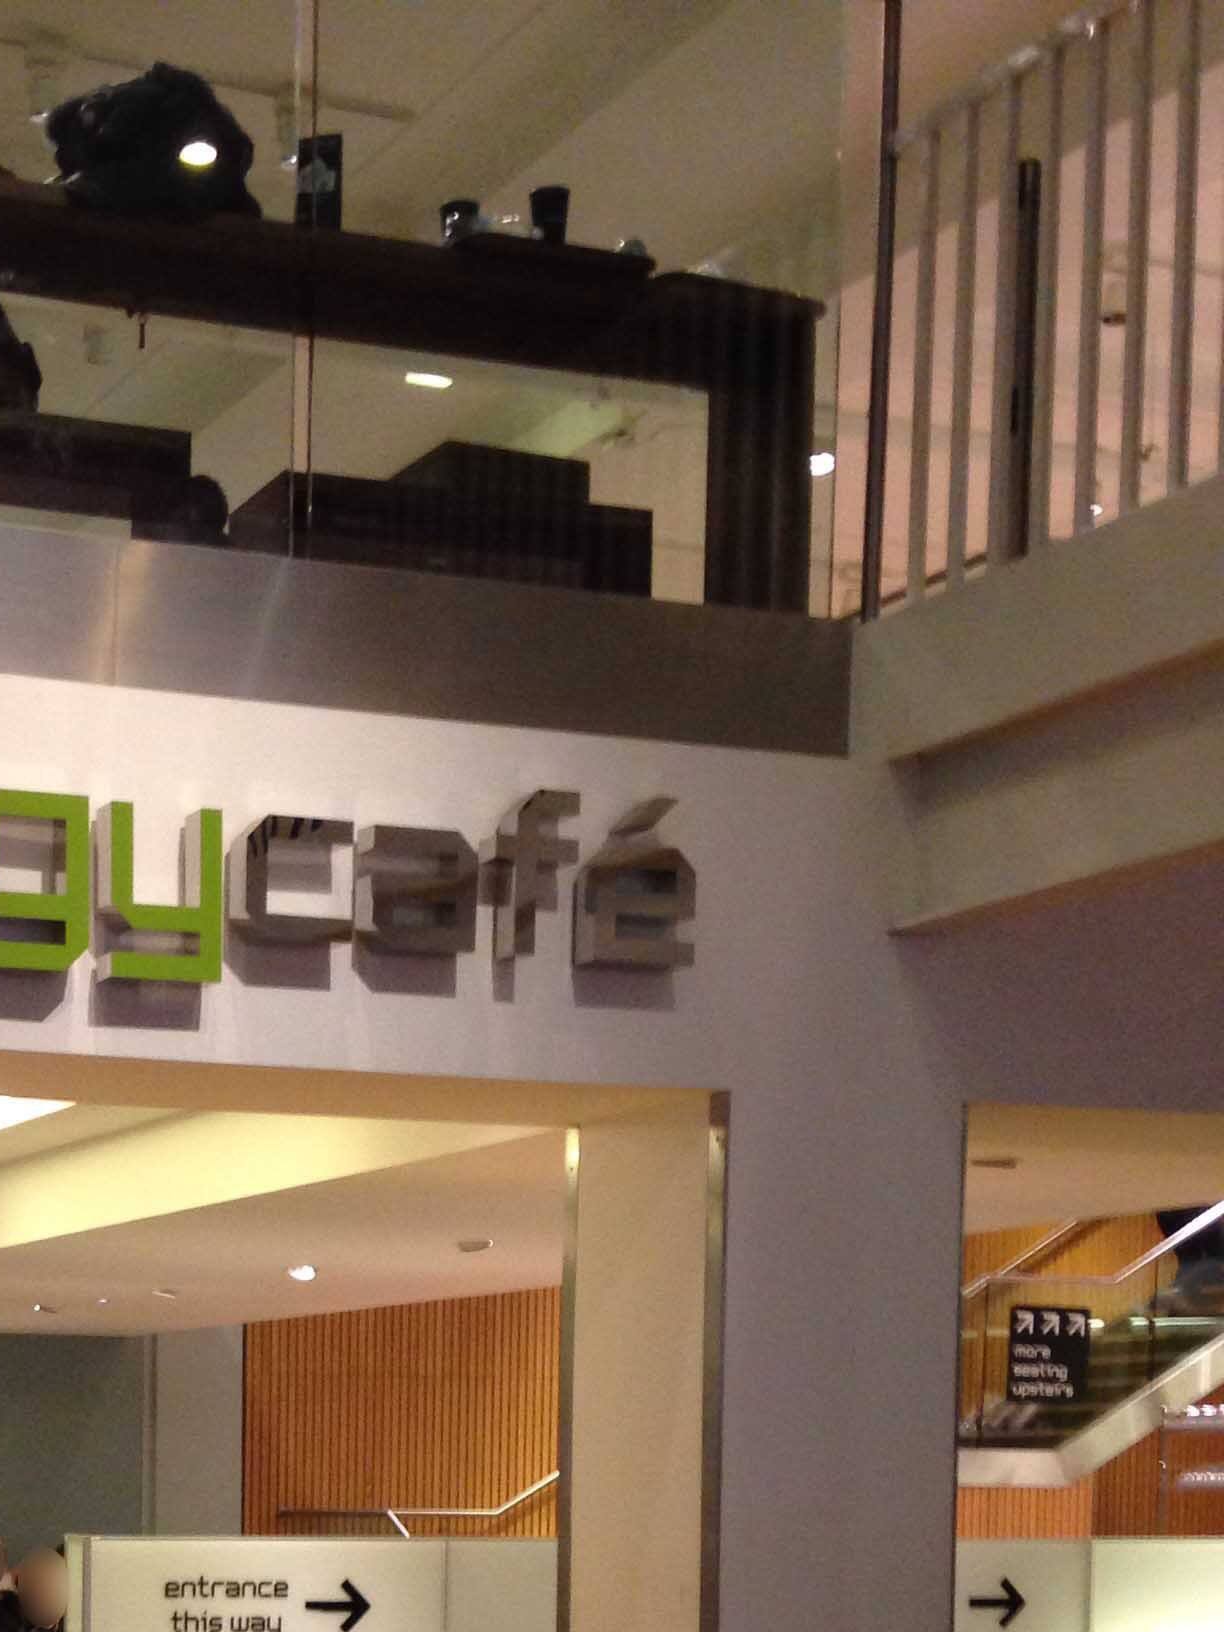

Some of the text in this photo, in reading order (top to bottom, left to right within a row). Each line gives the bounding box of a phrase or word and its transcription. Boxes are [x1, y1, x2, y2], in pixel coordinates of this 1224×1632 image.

[1012, 1343, 1051, 1359] more
[1013, 1362, 1068, 1382] seating
[1011, 1381, 1074, 1398] upstairs
[164, 1576, 289, 1599] entrance
